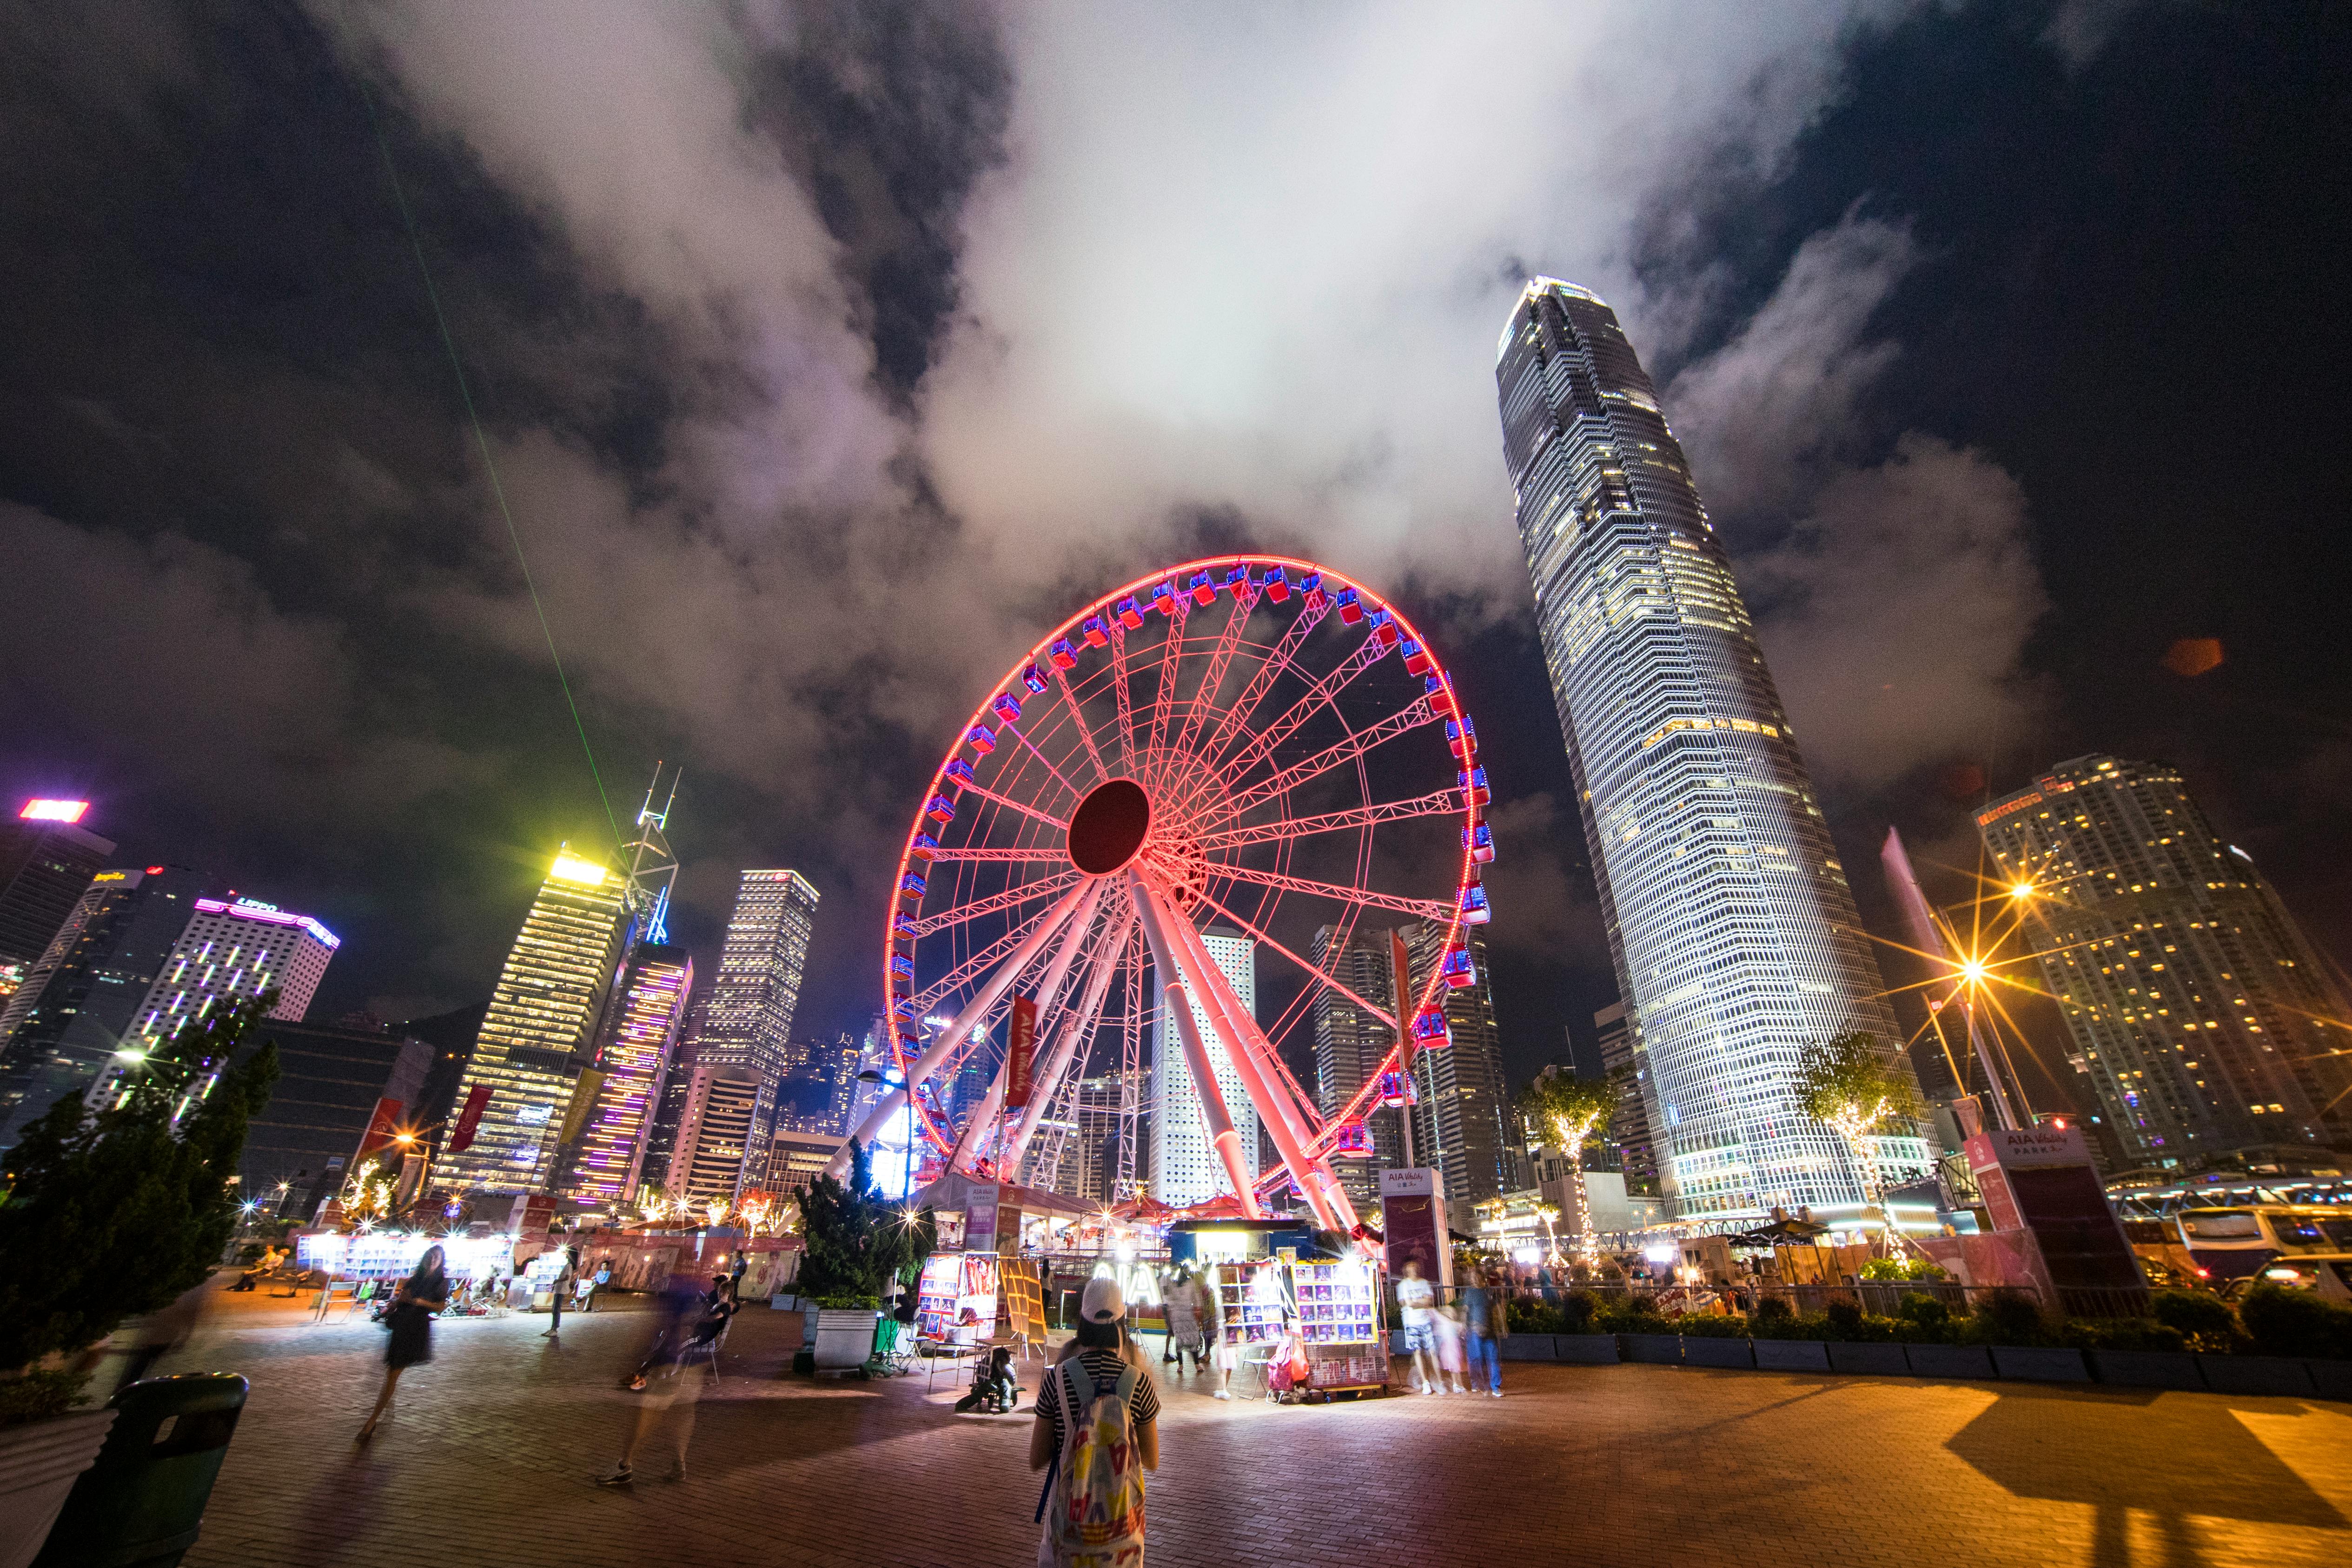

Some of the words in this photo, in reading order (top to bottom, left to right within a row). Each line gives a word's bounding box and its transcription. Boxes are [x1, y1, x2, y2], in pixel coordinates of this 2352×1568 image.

[237, 897, 278, 912] LIPPO
[1020, 1013, 1033, 1048] AIA
[2008, 1135, 2035, 1145] AIA
[1405, 1171, 1423, 1181] Vitality
